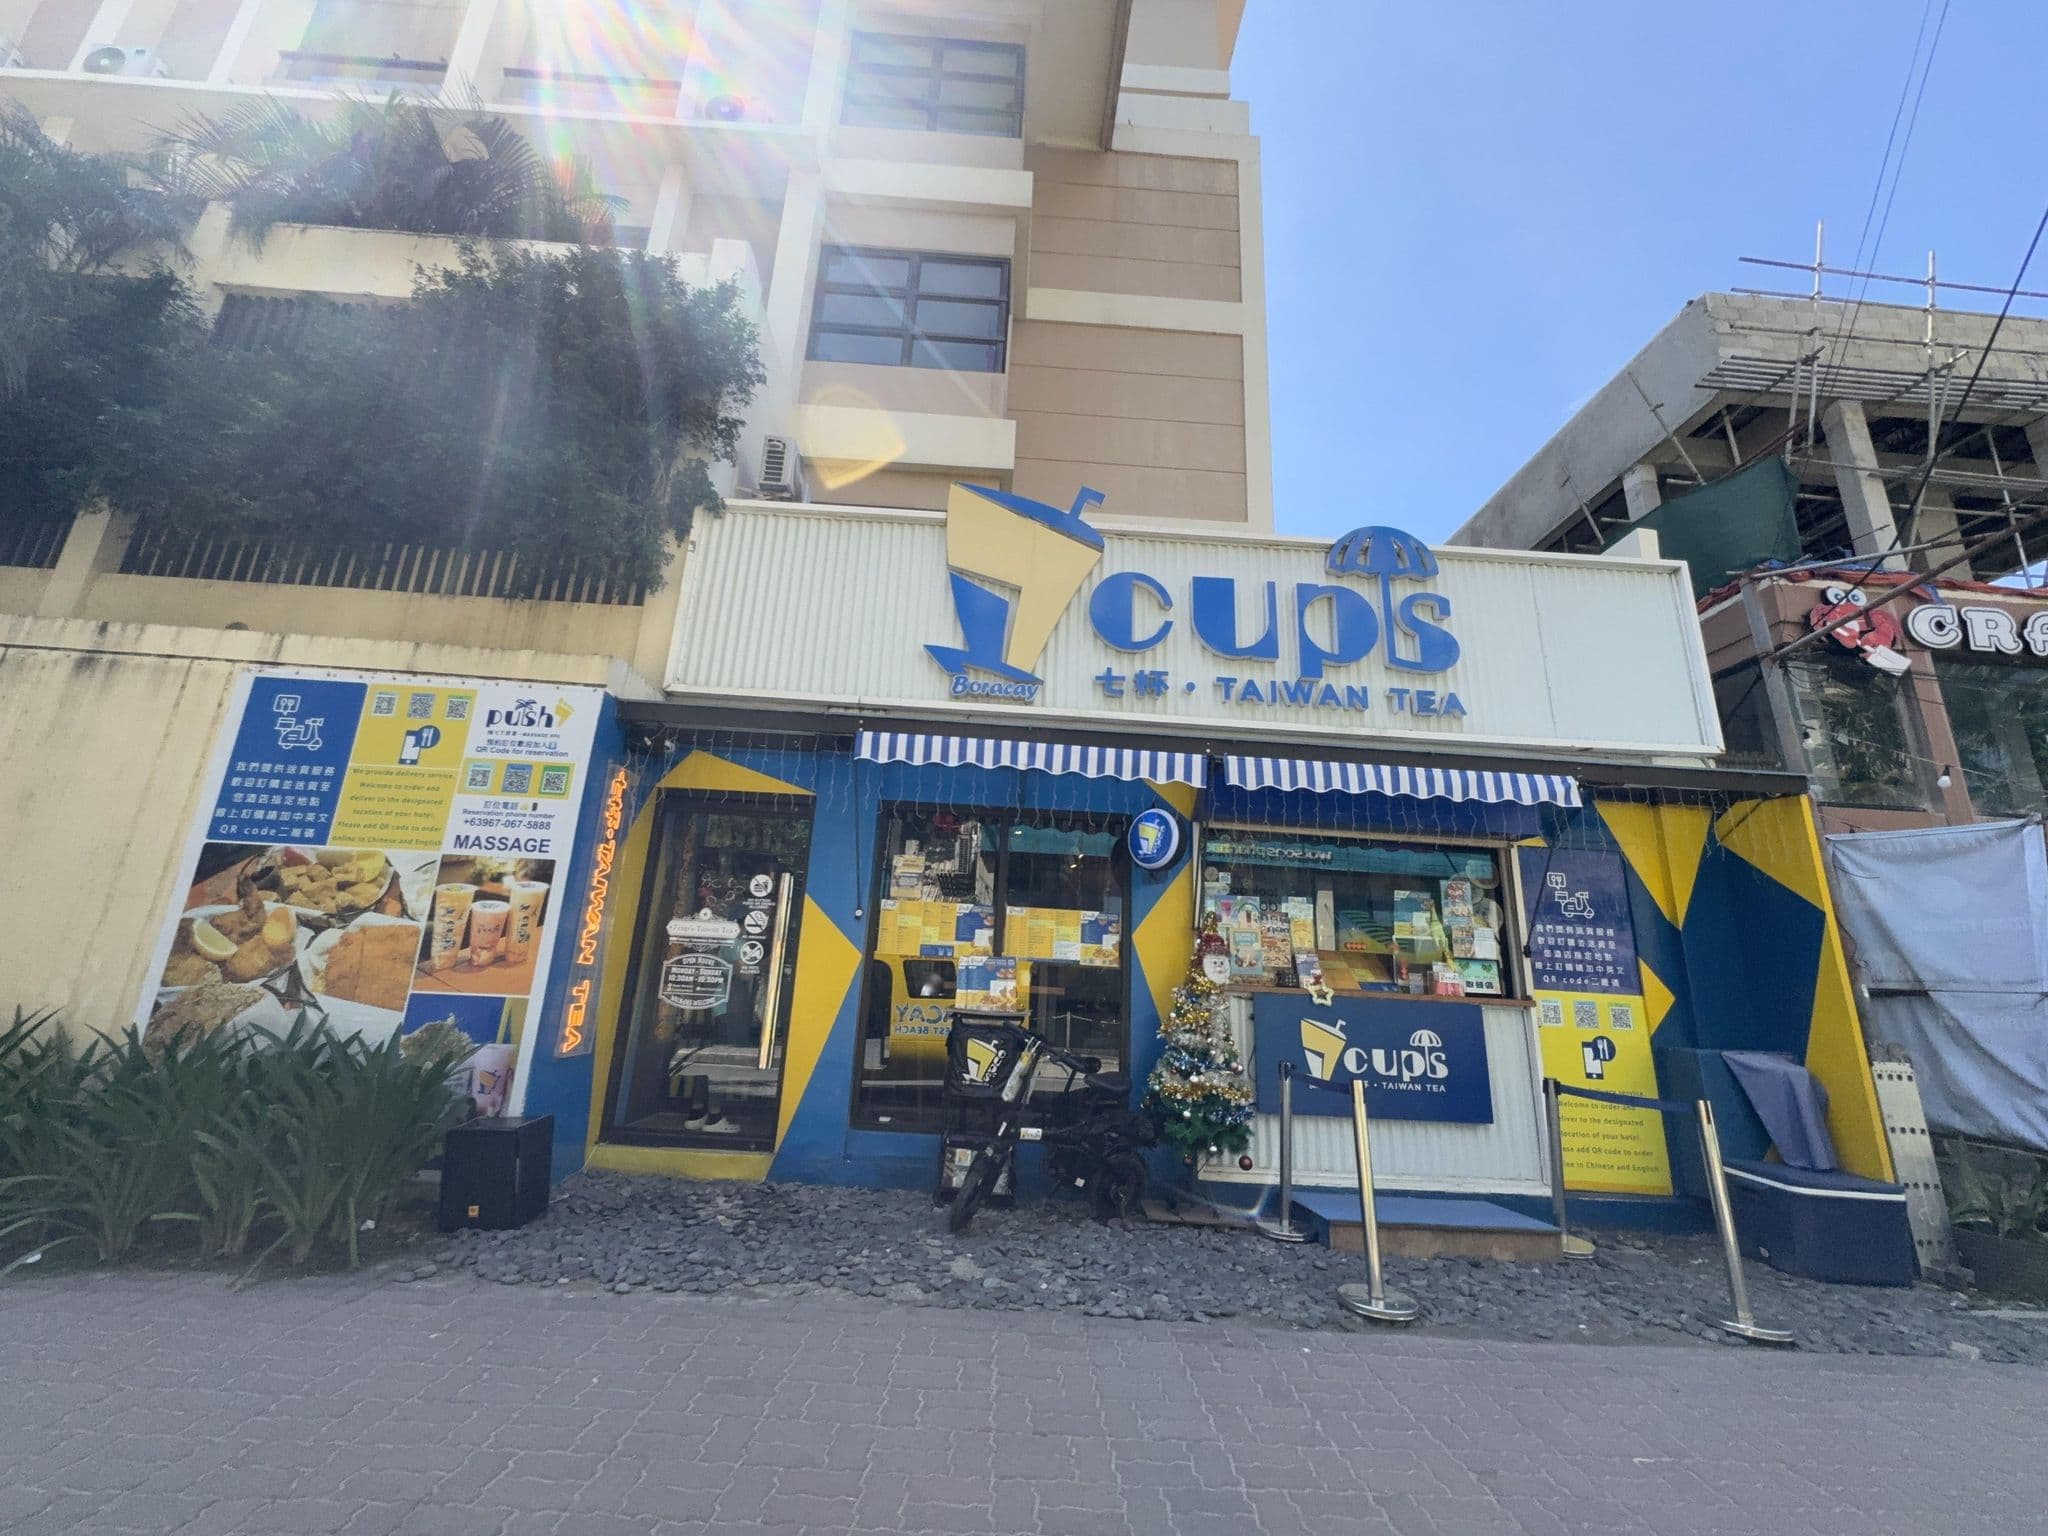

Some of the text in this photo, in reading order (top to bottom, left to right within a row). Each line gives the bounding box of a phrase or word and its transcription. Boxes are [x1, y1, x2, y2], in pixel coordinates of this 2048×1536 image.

[952, 674, 1039, 702] Boracay
[1096, 667, 1469, 718] 七杯 TAIWAN TEA
[490, 746, 510, 755] Code
[525, 749, 568, 757] reservation
[462, 808, 504, 817] Reservation
[505, 811, 527, 819] phone
[219, 824, 238, 835] QR
[453, 834, 552, 854] MASSAGE
[576, 840, 617, 965] TAIWAN
[1542, 974, 1557, 984] QR
[562, 979, 592, 1054] TEA
[1343, 1047, 1449, 1082] cups
[1382, 1081, 1422, 1092] TAIWAN
[1425, 1083, 1447, 1093] TEA
[1590, 1116, 1601, 1124] the
[1603, 1118, 1645, 1127] designated
[1576, 1161, 1584, 1169] in
[1586, 1162, 1614, 1170] Chinese
[1632, 1164, 1661, 1173] English
